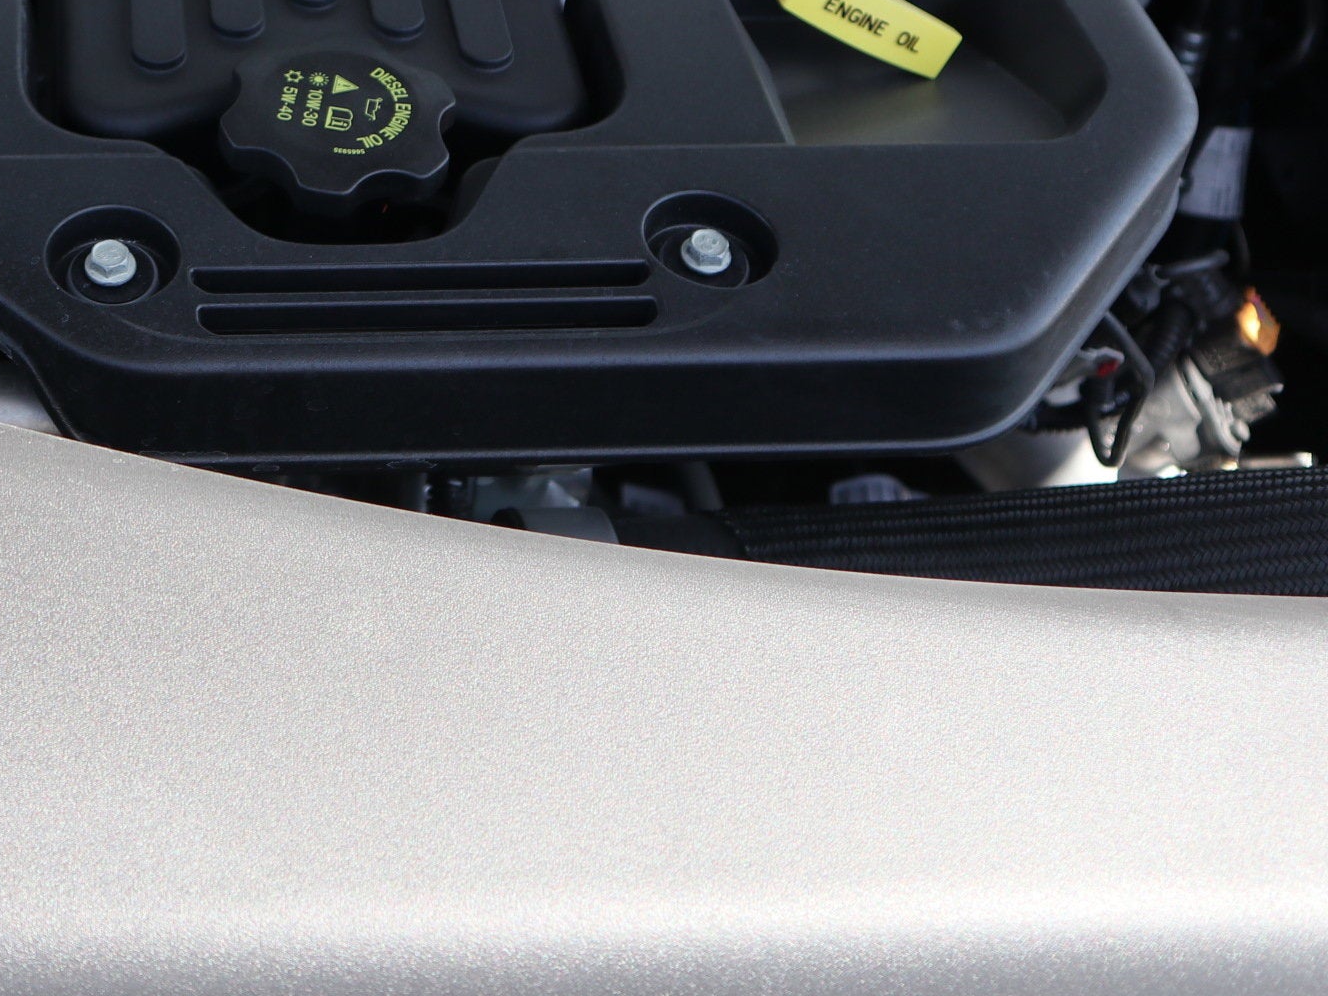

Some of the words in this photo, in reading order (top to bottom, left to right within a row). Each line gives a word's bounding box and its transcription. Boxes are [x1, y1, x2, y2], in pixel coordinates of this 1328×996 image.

[896, 31, 920, 54] OIL
[370, 67, 409, 102] DIESEL
[276, 85, 299, 122] 5W-40
[302, 89, 323, 127] 10W-30
[379, 103, 412, 140] ENGINE
[356, 133, 383, 149] OIL
